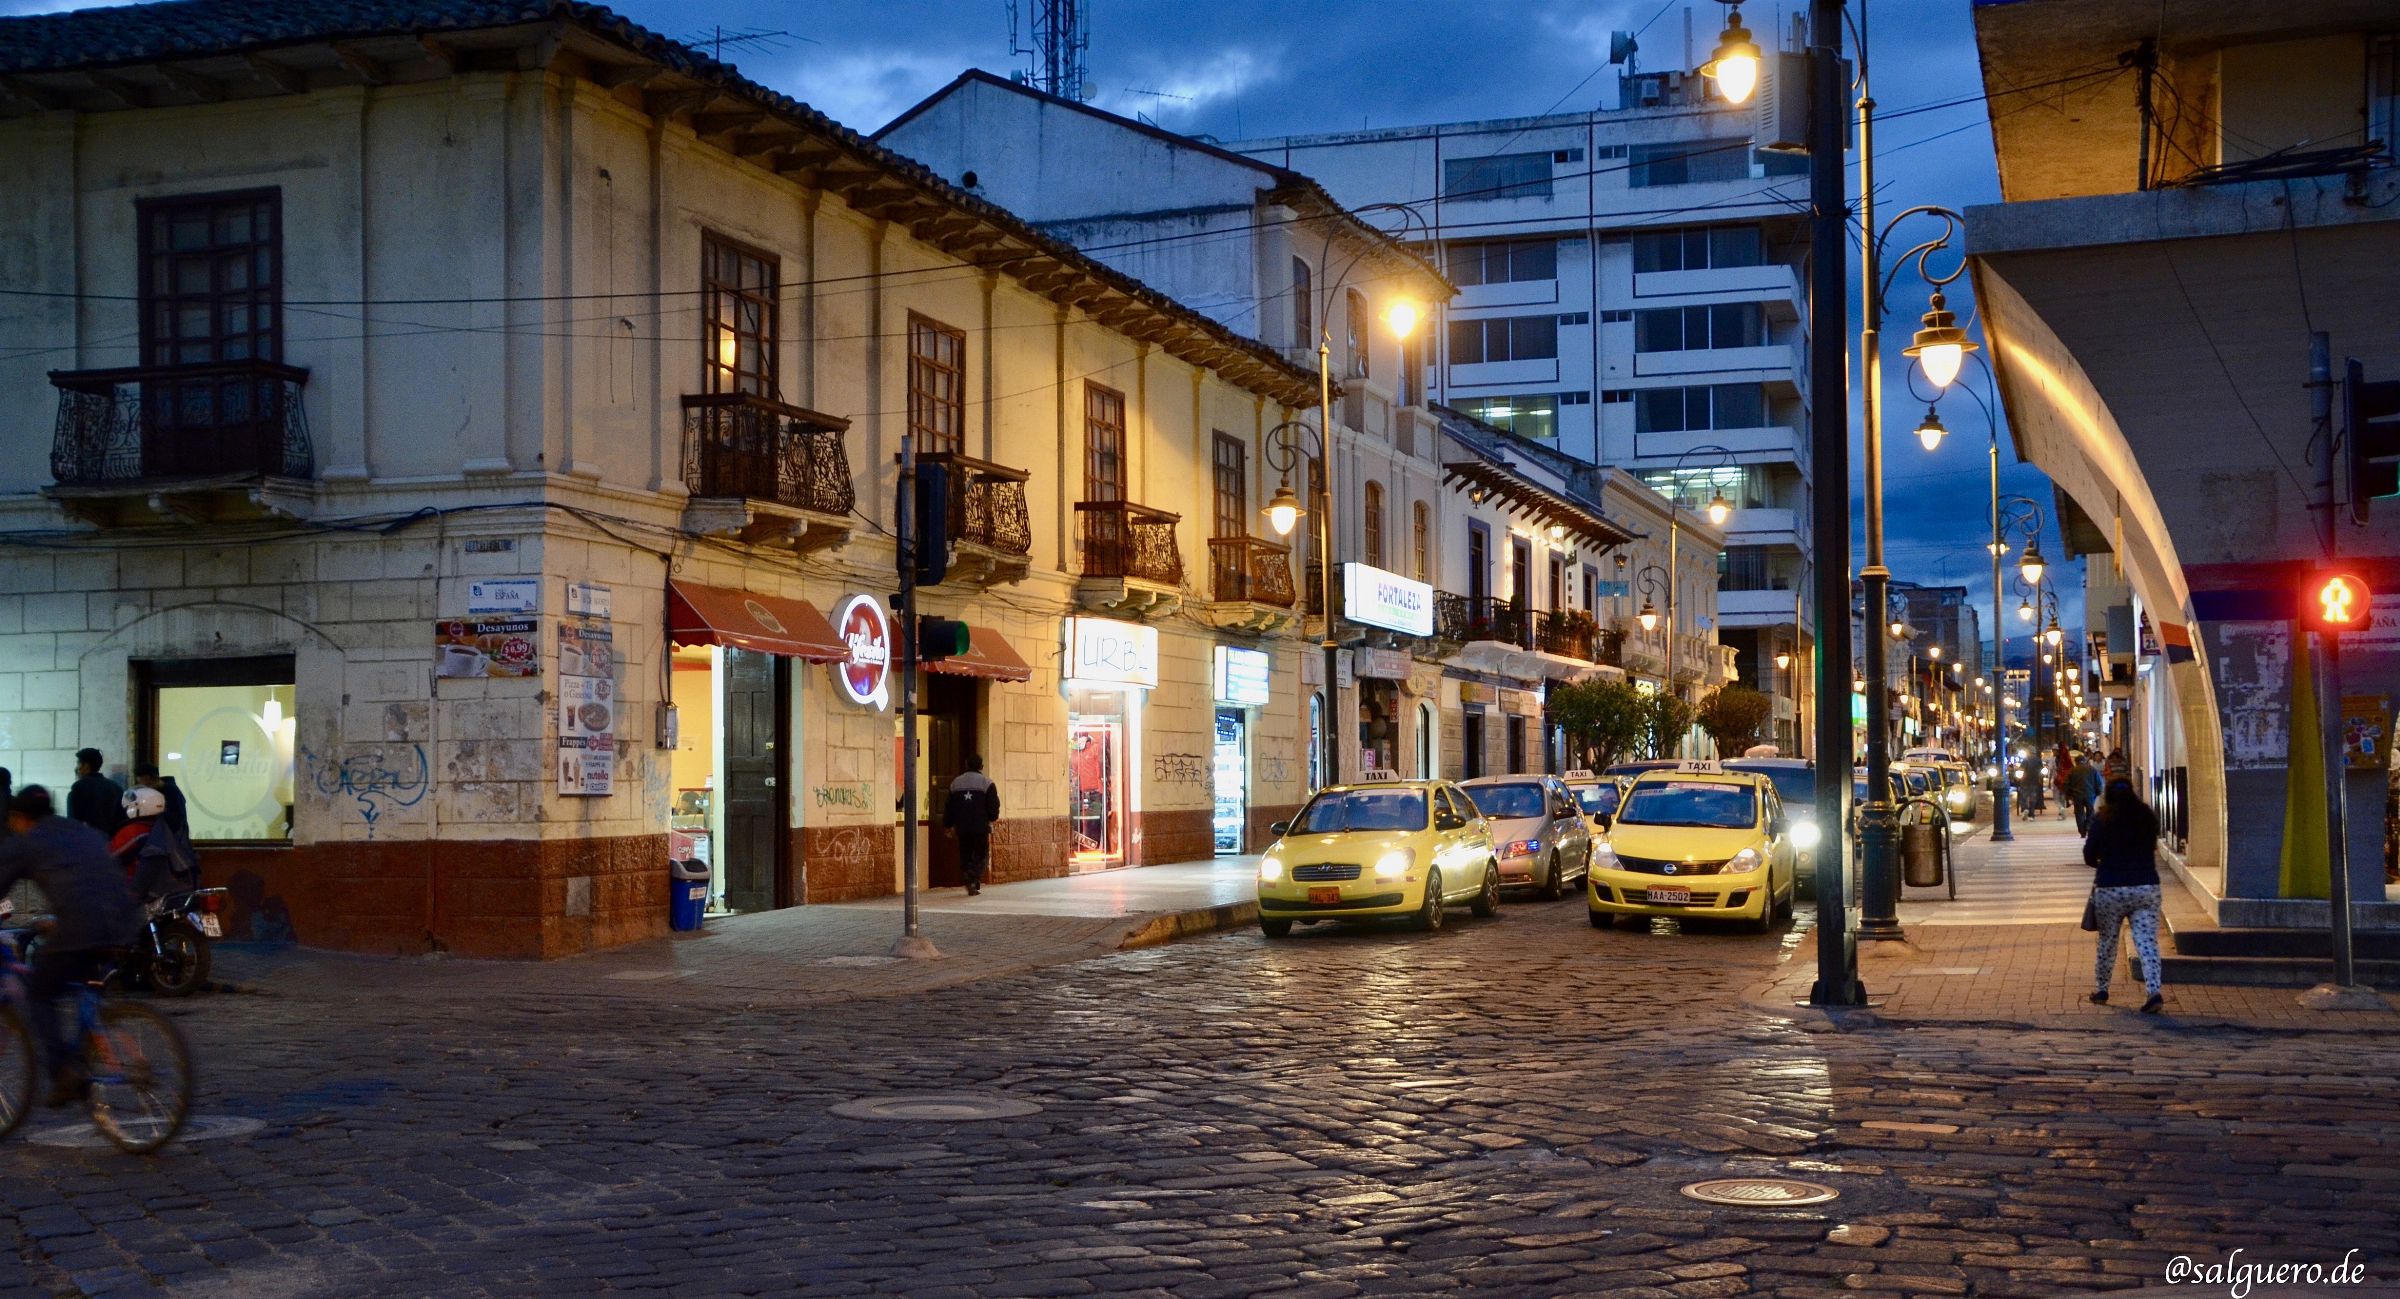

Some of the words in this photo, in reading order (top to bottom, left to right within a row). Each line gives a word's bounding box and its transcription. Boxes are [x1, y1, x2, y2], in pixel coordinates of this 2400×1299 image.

[495, 590, 519, 600] ESPAÑA
[1378, 583, 1422, 611] FORTALEZA
[477, 623, 529, 634] Desayunos
[1688, 761, 1711, 771] TAXI
[587, 770, 609, 780] nutella
[1364, 771, 1388, 781] TAXI
[1647, 890, 1689, 902] HAA-2502
